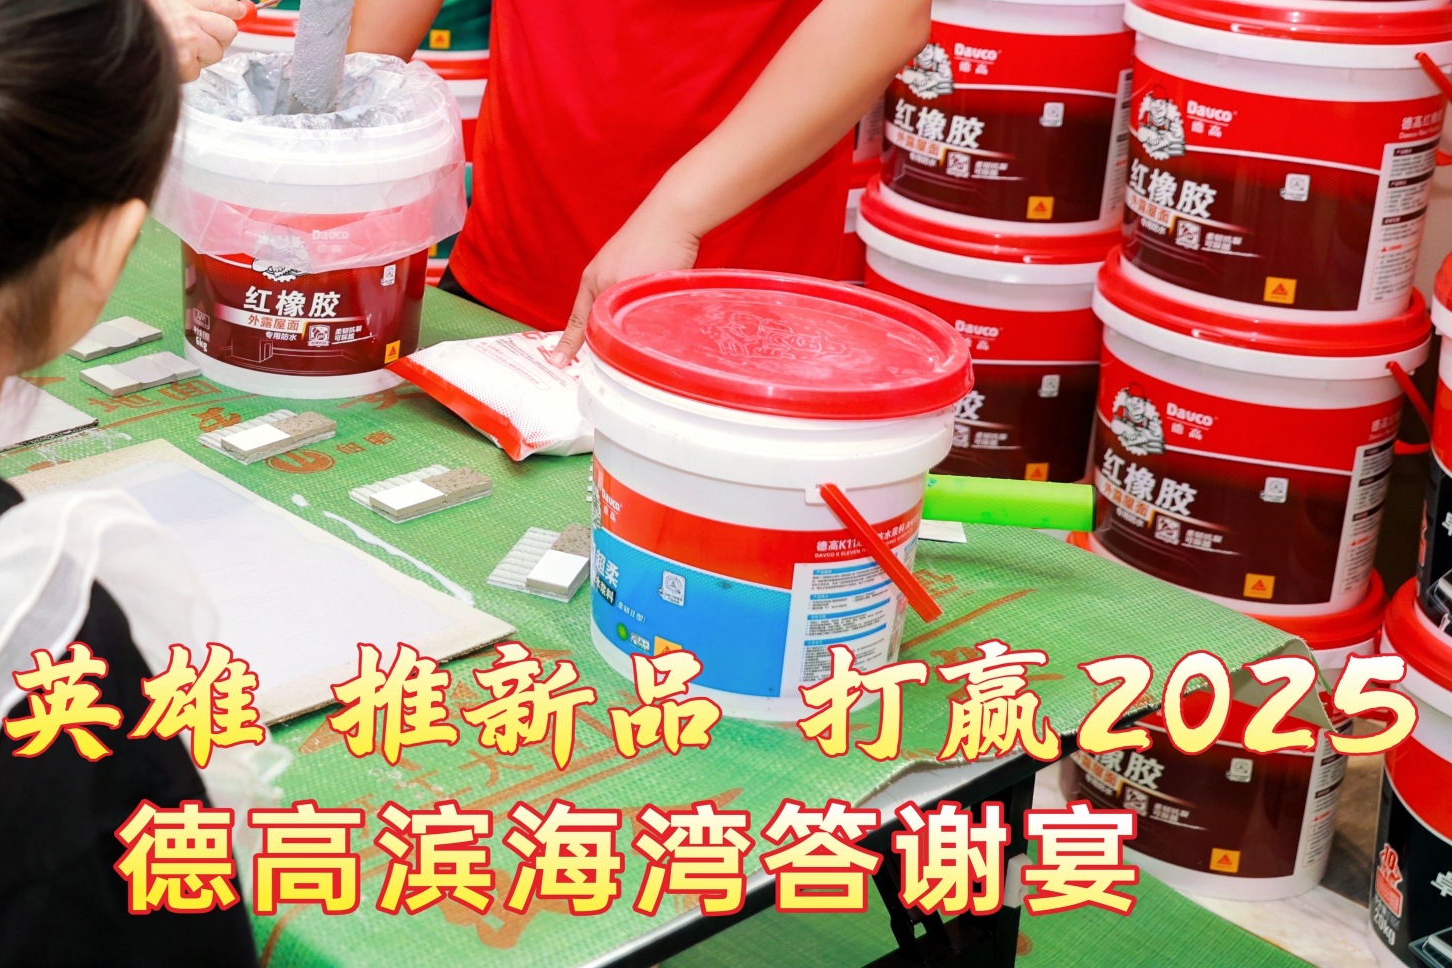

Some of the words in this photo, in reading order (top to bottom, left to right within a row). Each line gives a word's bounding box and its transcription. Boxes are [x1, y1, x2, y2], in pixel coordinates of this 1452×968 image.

[894, 98, 986, 149] 红橡胶
[1129, 158, 1217, 219] 红橡胶
[243, 285, 341, 318] 红橡胶
[248, 314, 300, 331] 外露屋面
[265, 331, 298, 342] 专用防水
[195, 337, 208, 352] 6kg
[1102, 448, 1198, 517] 红橡胶
